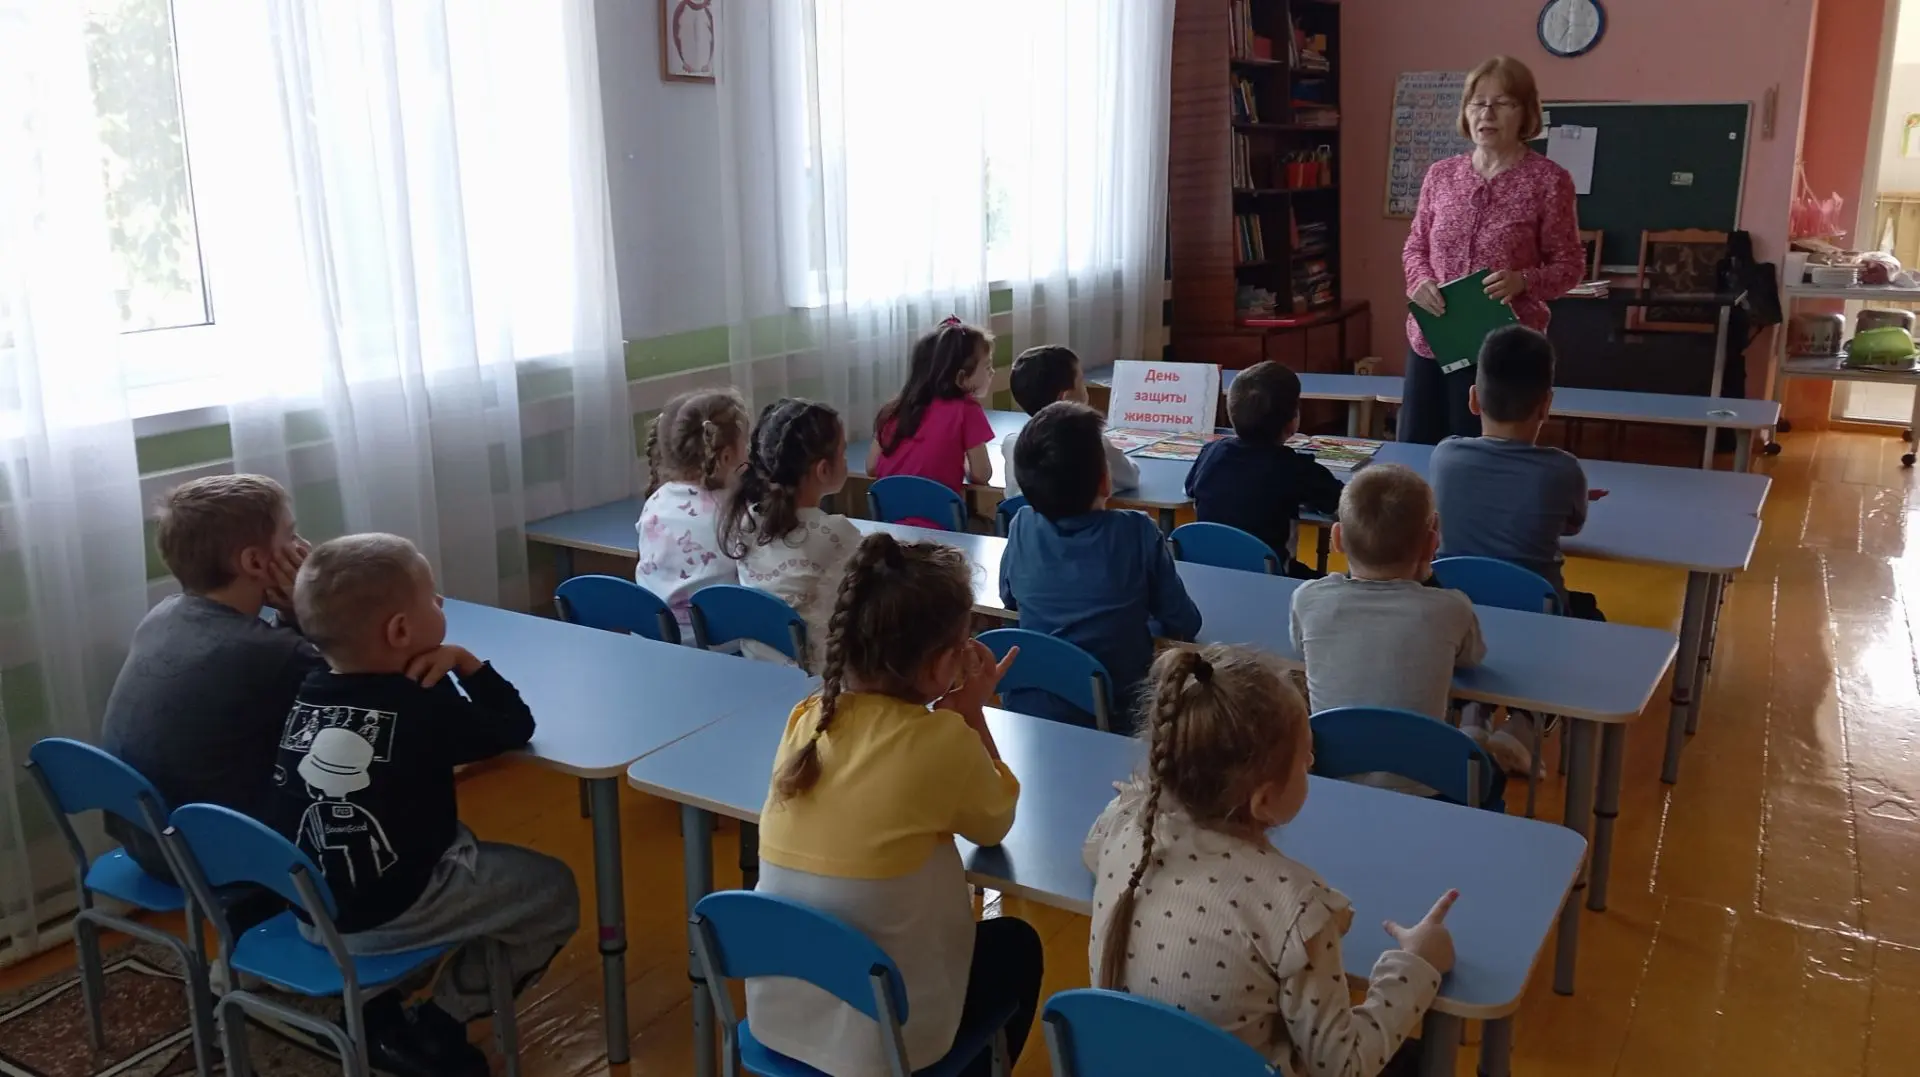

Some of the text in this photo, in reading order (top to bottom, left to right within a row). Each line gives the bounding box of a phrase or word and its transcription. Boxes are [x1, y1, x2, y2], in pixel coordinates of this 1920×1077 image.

[1144, 369, 1180, 383] День
[1134, 391, 1187, 405] защиты
[1124, 412, 1193, 425] животных
